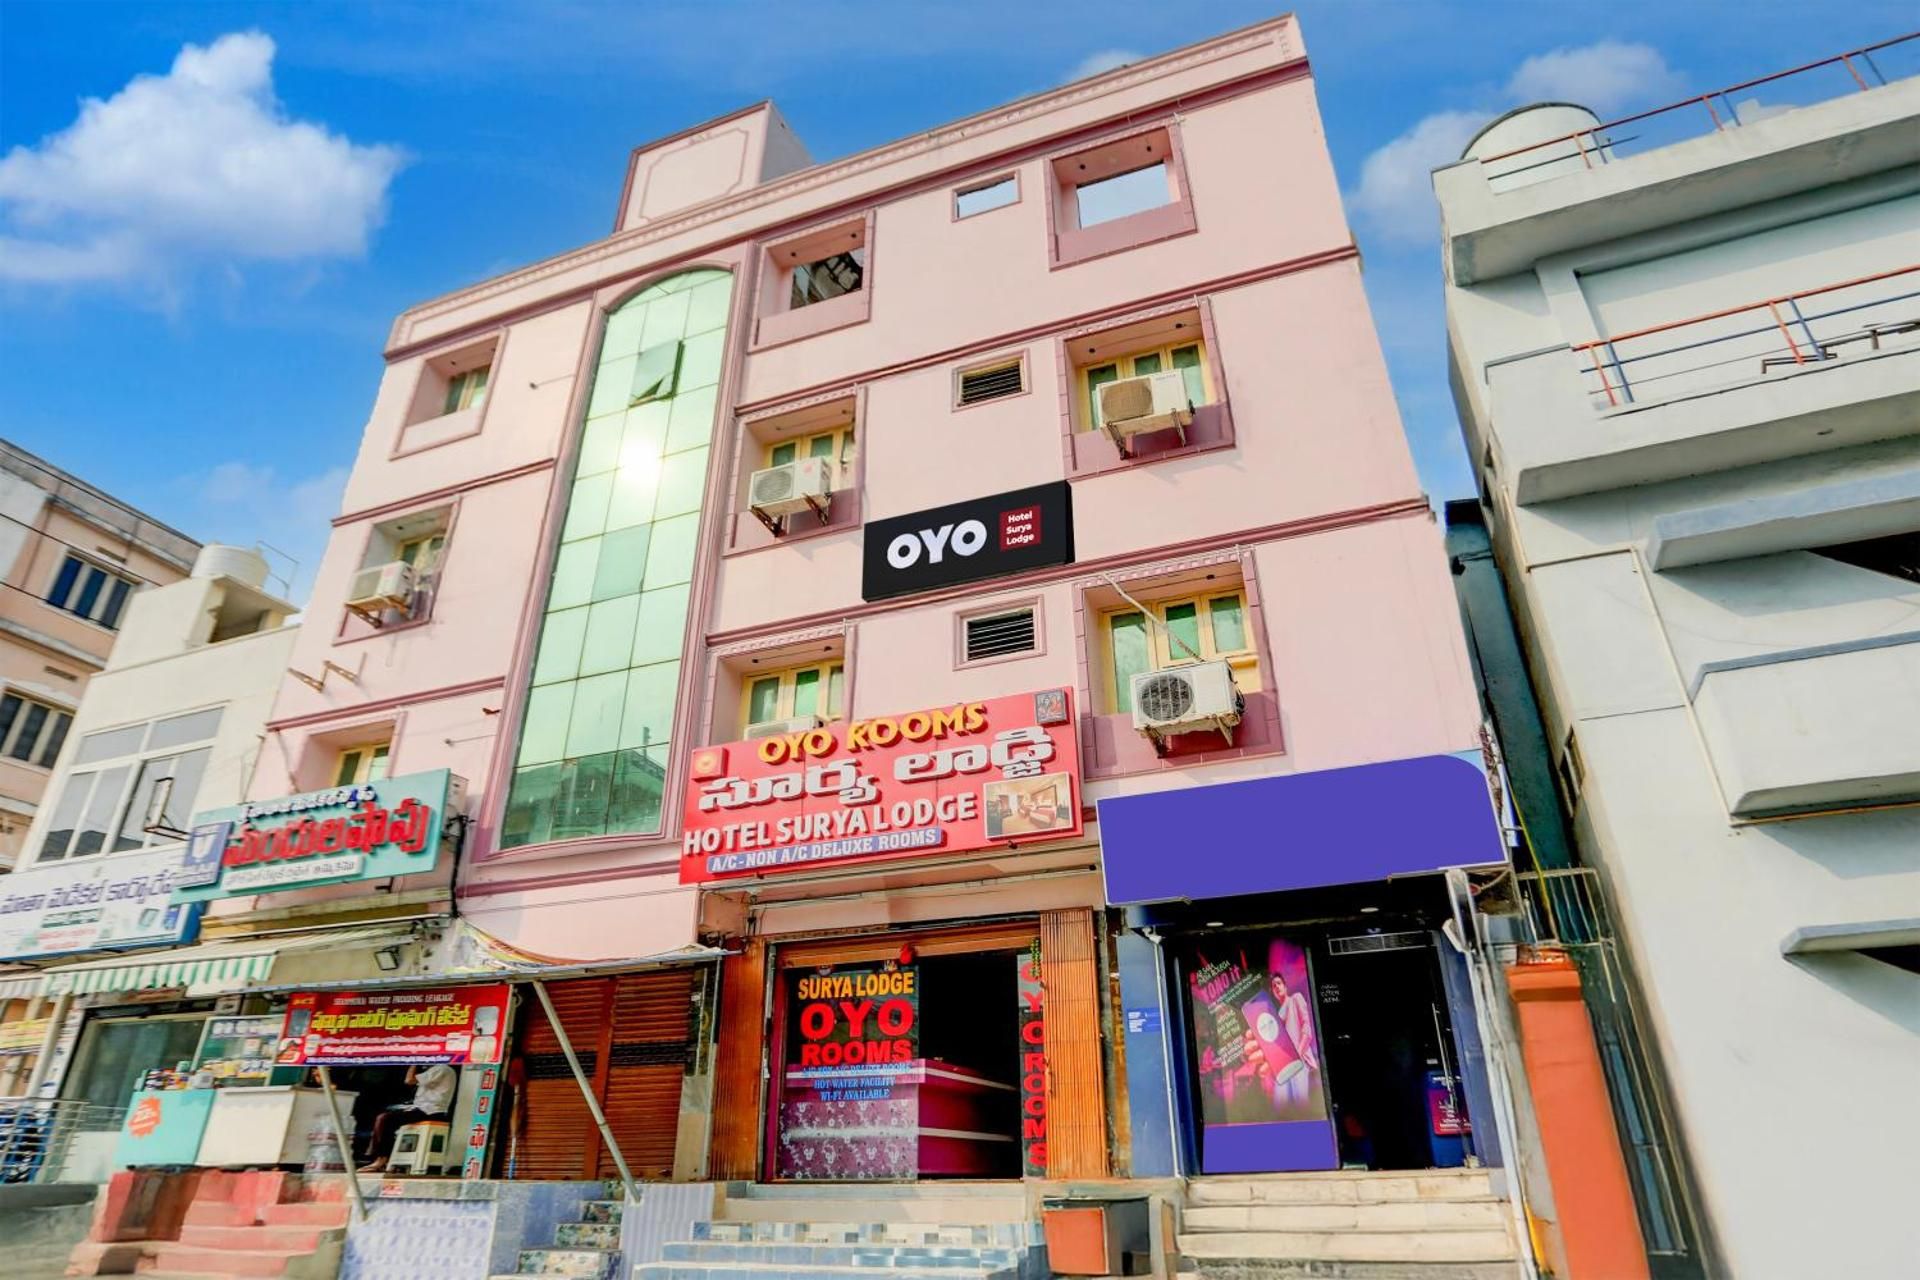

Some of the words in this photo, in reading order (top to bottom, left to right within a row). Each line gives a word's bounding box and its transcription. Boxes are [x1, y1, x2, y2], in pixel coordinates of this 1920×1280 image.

[1006, 523, 1032, 535] Surya
[1008, 510, 1033, 523] Hotel
[887, 519, 988, 569] OYO
[1006, 533, 1035, 545] Lodge
[758, 731, 834, 764] OYO
[848, 704, 988, 751] ROOMS
[698, 757, 880, 812] సూర్య
[683, 822, 772, 856] HOTEL
[776, 807, 870, 843] SURYA
[872, 792, 978, 832] LODGE
[781, 846, 808, 864] A/C
[810, 838, 873, 860] DELUXE
[878, 828, 937, 850] ROOMS
[798, 975, 854, 999] SURYA
[855, 971, 915, 997] LODGE
[800, 998, 915, 1041] OYO
[801, 1039, 913, 1068] ROOMS
[831, 1077, 859, 1088] WATER
[842, 1089, 891, 1101] AVAILABLE
